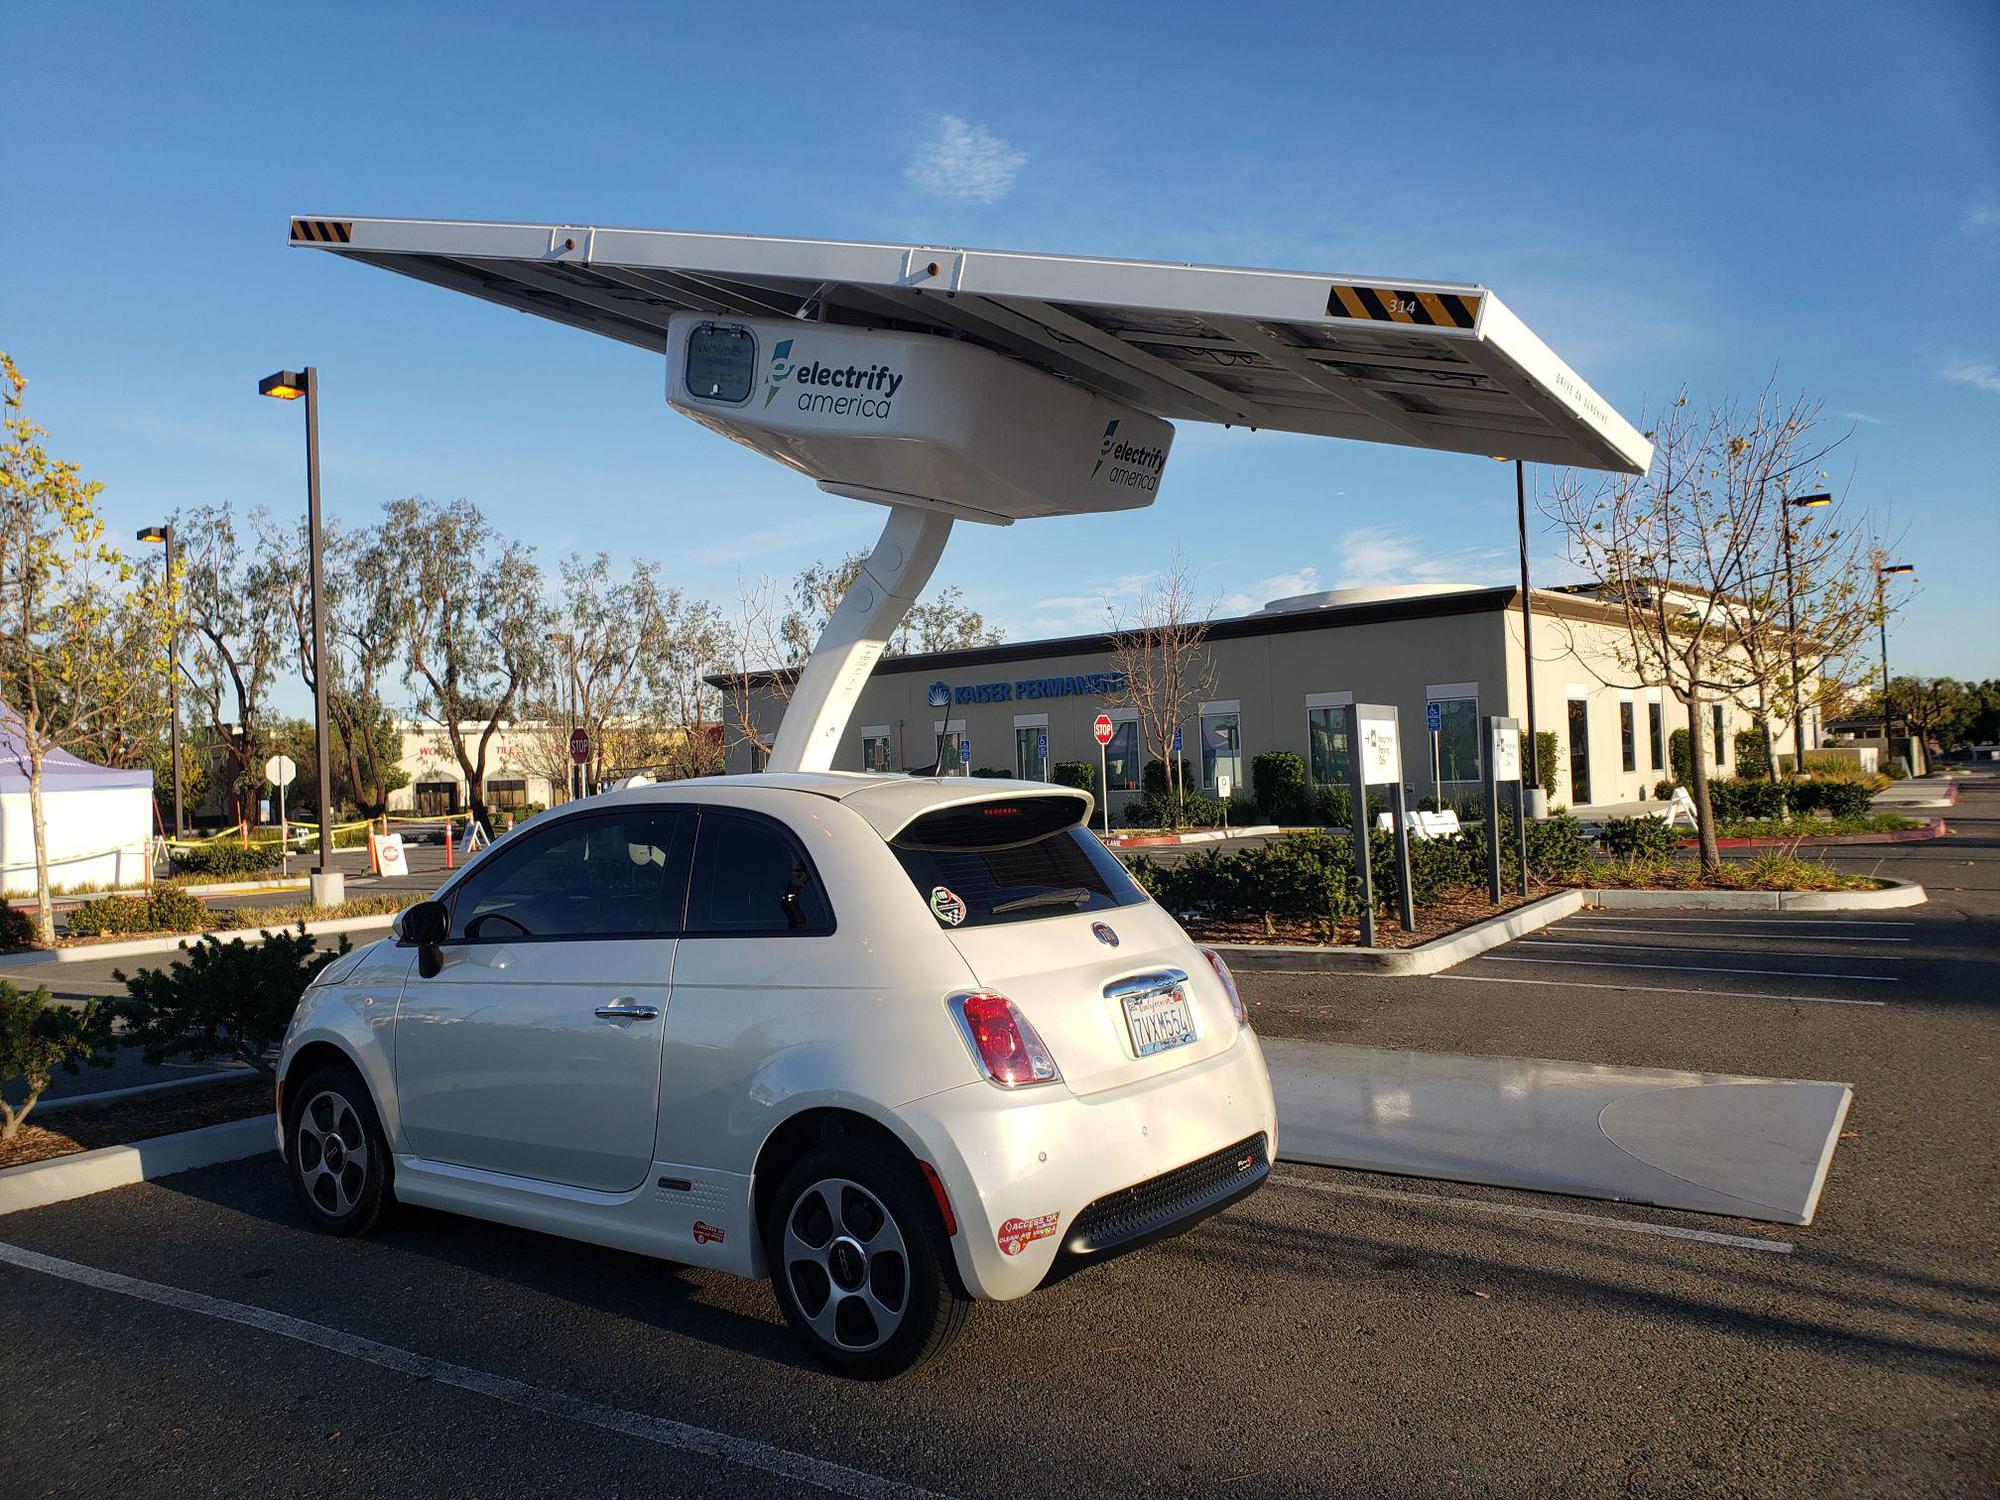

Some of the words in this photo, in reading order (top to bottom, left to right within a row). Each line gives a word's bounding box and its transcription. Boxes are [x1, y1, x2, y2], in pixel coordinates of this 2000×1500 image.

[1388, 299, 1416, 314] 314
[796, 360, 903, 398] electrify
[797, 392, 892, 419] america
[1113, 439, 1166, 474] electrify
[1109, 466, 1157, 490] america
[954, 682, 1011, 704] KAISER
[1095, 723, 1111, 736] STOP
[571, 740, 588, 754] STOP
[1134, 1009, 1188, 1044] 7VXM554
